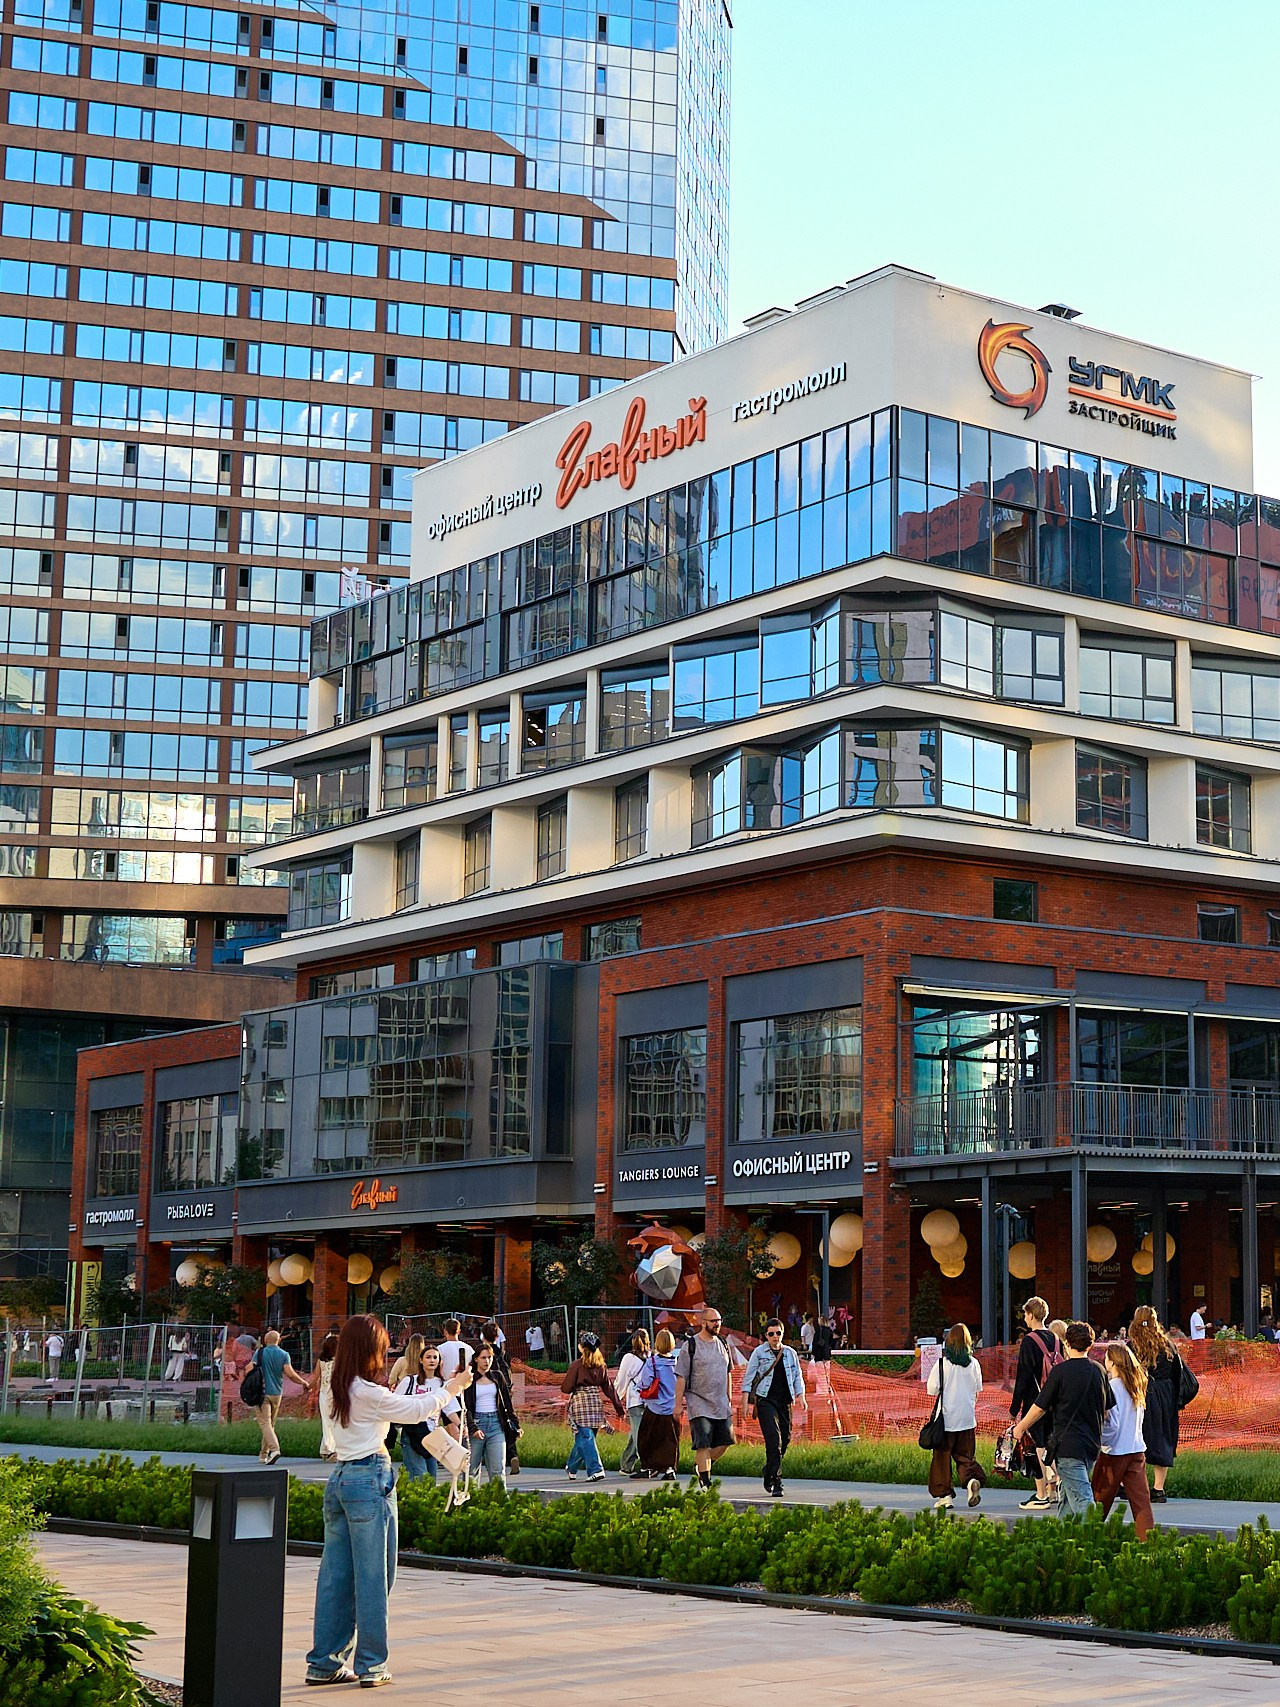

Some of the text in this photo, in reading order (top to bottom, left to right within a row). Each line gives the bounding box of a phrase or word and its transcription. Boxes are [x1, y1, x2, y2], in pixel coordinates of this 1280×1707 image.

[731, 362, 847, 422] гастромолл
[1069, 356, 1176, 410] УГМК
[1069, 400, 1177, 440] ЗАСТРОЙЩИК
[555, 396, 707, 509] Главный
[427, 481, 542, 540] офисный центр
[619, 1165, 699, 1182] TANGIERS LOUNGE
[733, 1151, 851, 1178] ОФИСНЫЙ ЦЕНТР
[351, 1178, 398, 1210] Главный
[85, 1208, 135, 1227] гастромолл
